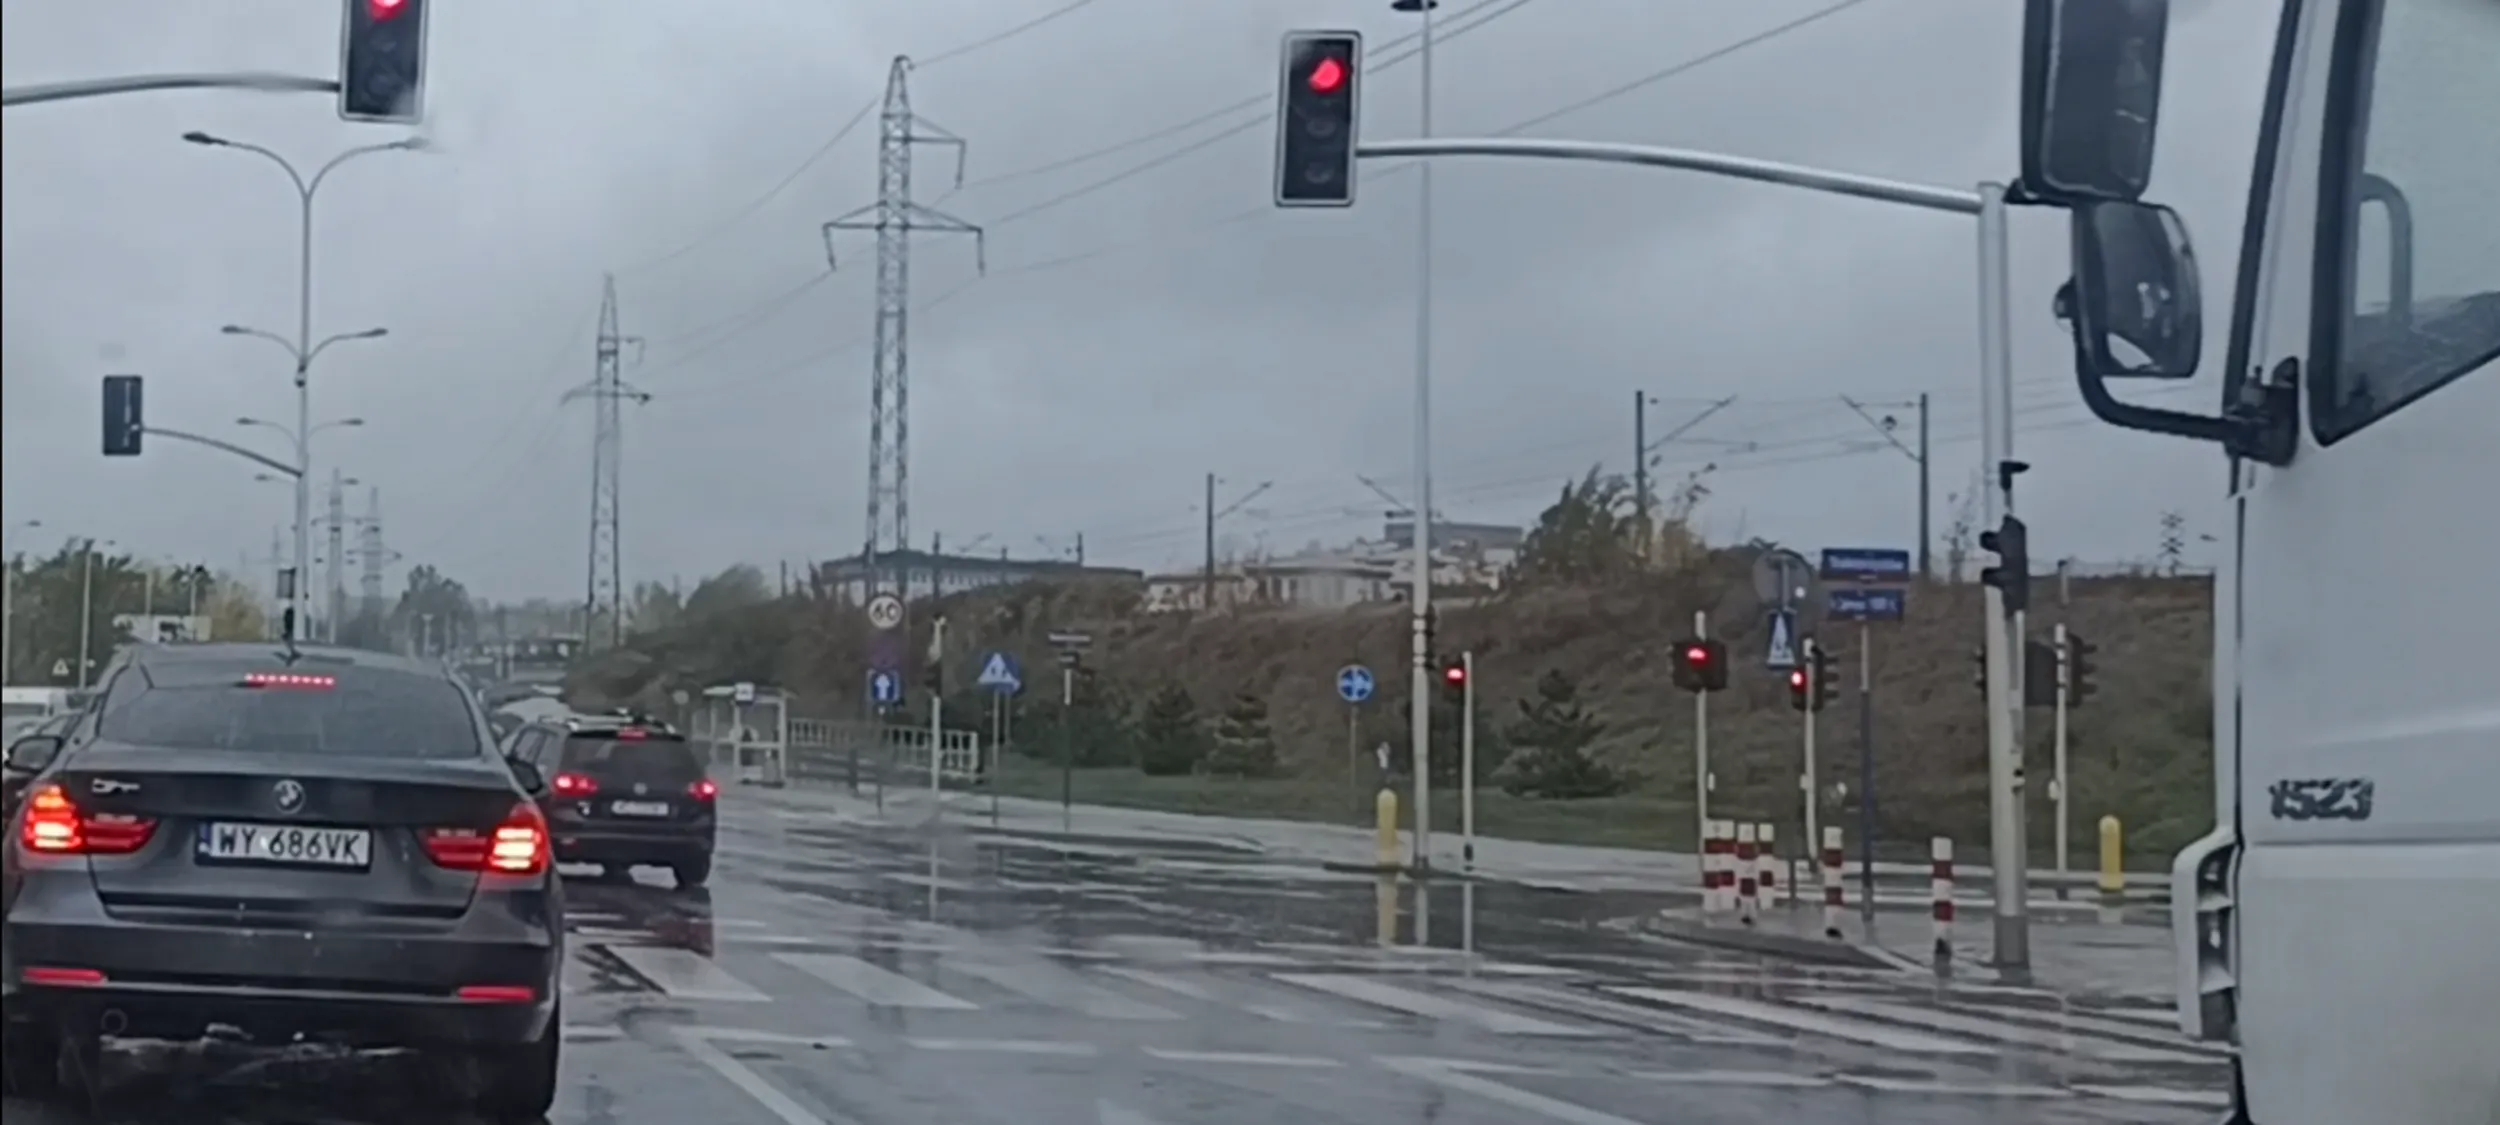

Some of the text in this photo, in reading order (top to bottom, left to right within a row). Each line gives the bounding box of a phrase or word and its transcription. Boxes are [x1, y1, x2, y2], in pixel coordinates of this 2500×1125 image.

[873, 602, 901, 622] 60
[2268, 779, 2374, 821] 1523
[219, 827, 361, 866] WY 686VK
